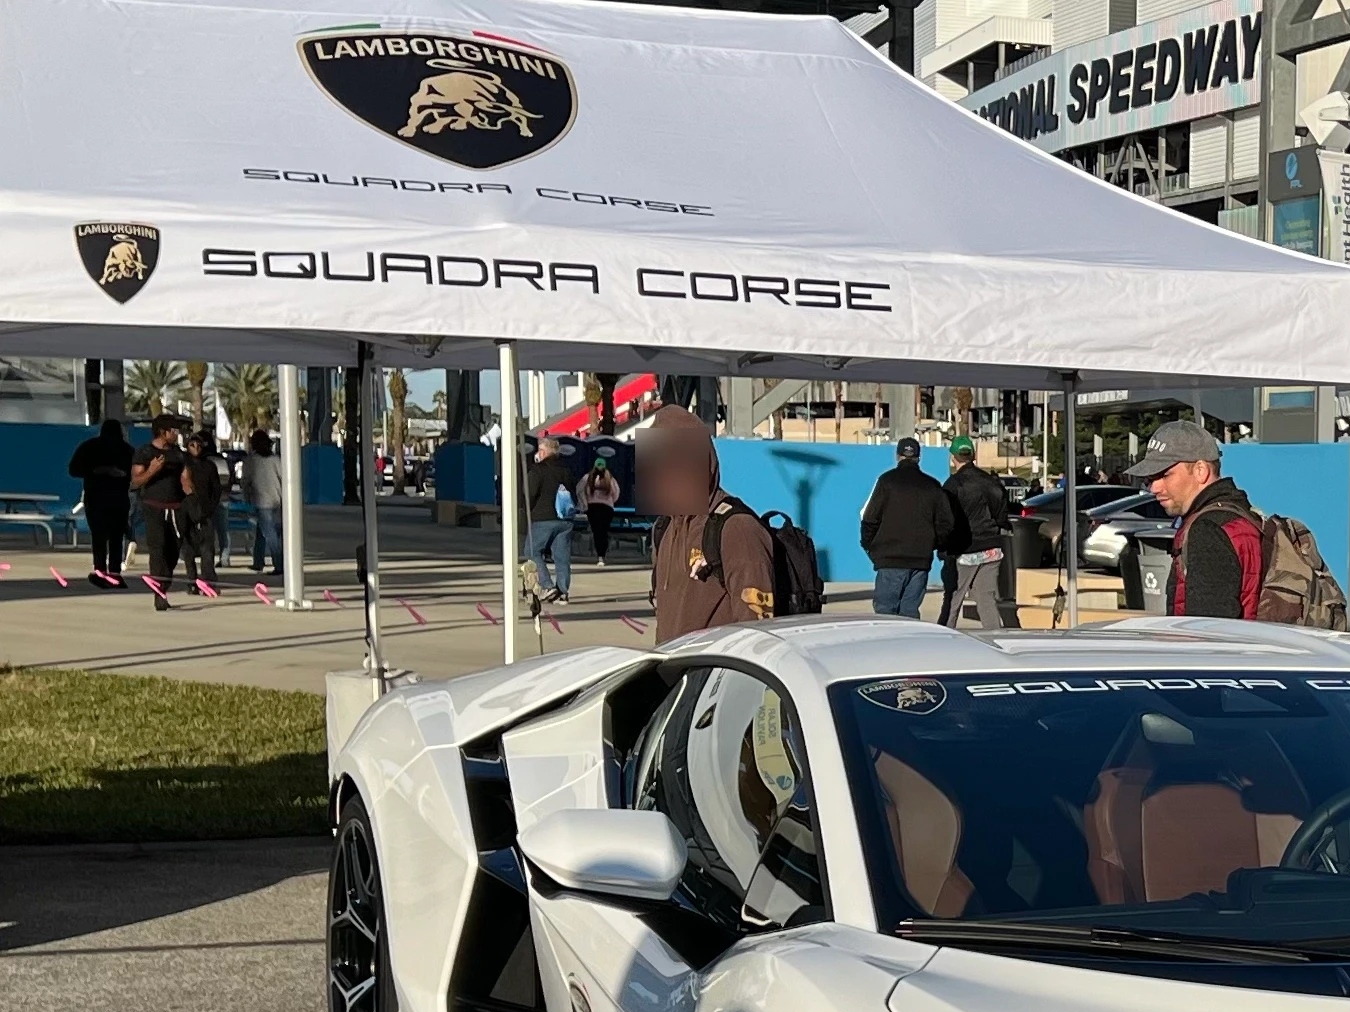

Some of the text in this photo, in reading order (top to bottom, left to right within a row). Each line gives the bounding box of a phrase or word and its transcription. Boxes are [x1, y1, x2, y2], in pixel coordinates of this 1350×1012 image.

[313, 37, 558, 80] LAMBORGHINI
[1067, 12, 1262, 125] SPEEDWAY
[242, 167, 715, 217] SQUADRA CORSE
[77, 223, 157, 241] LAMBORGHINI
[202, 247, 893, 313] SQUADRA CORSE
[863, 679, 938, 695] LAMBORGHINI
[966, 678, 1287, 697] SQUADRA
